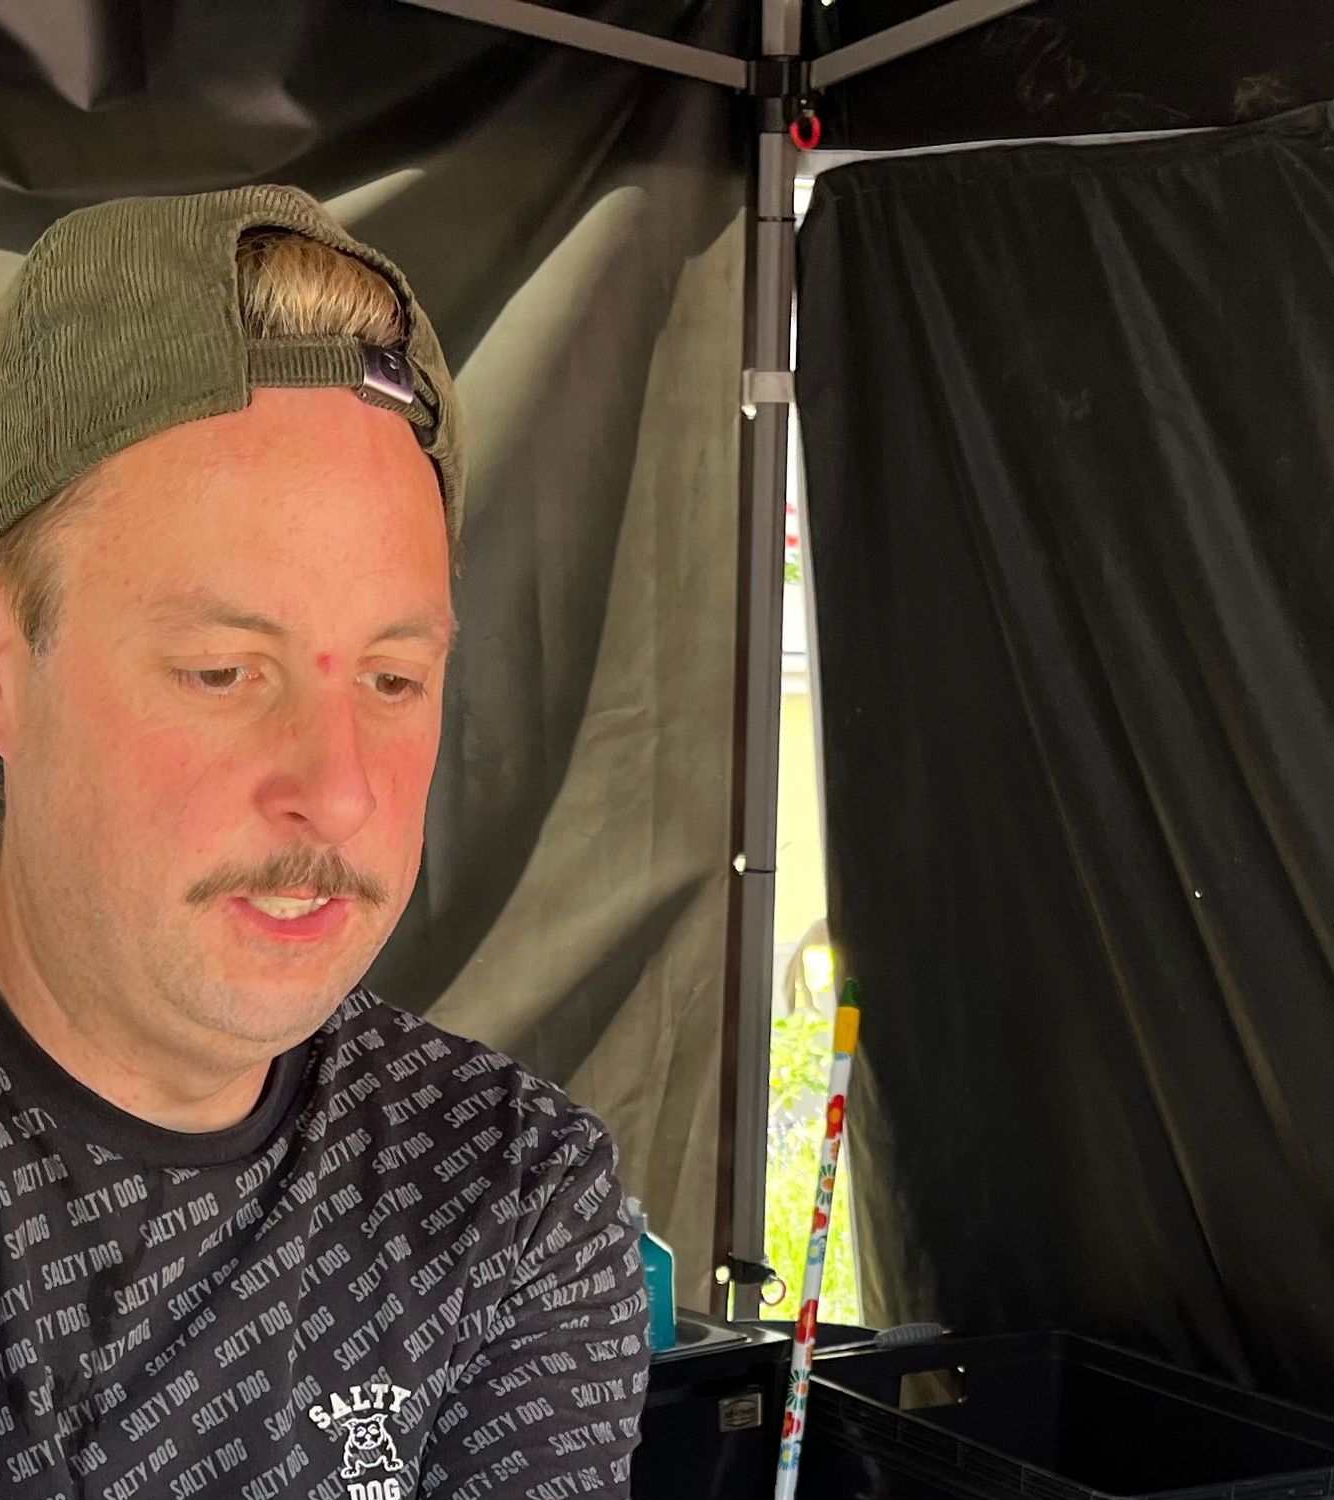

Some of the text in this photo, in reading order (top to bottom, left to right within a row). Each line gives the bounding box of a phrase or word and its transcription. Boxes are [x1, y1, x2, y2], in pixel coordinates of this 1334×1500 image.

[385, 1048, 428, 1083] SALTY
[433, 1125, 503, 1183] SALTY DOG
[66, 1173, 148, 1227] SALTY DOG
[138, 1191, 220, 1249] SALTY DOG
[41, 1239, 124, 1291] SALTY DOG
[230, 1234, 308, 1301] SALTY DOG
[113, 1271, 159, 1316] SALTY
[213, 1300, 294, 1369] SALTY DOG
[333, 1292, 405, 1372] SALTY DOG
[119, 1369, 200, 1442] SALTY DOG
[190, 1369, 272, 1435] SALTY DOG
[487, 1358, 544, 1397] SALTY
[308, 1384, 412, 1429] SALTY
[462, 1396, 555, 1455] SALTY DOG
[147, 1437, 178, 1476] DOG
[214, 1437, 248, 1473] DOG
